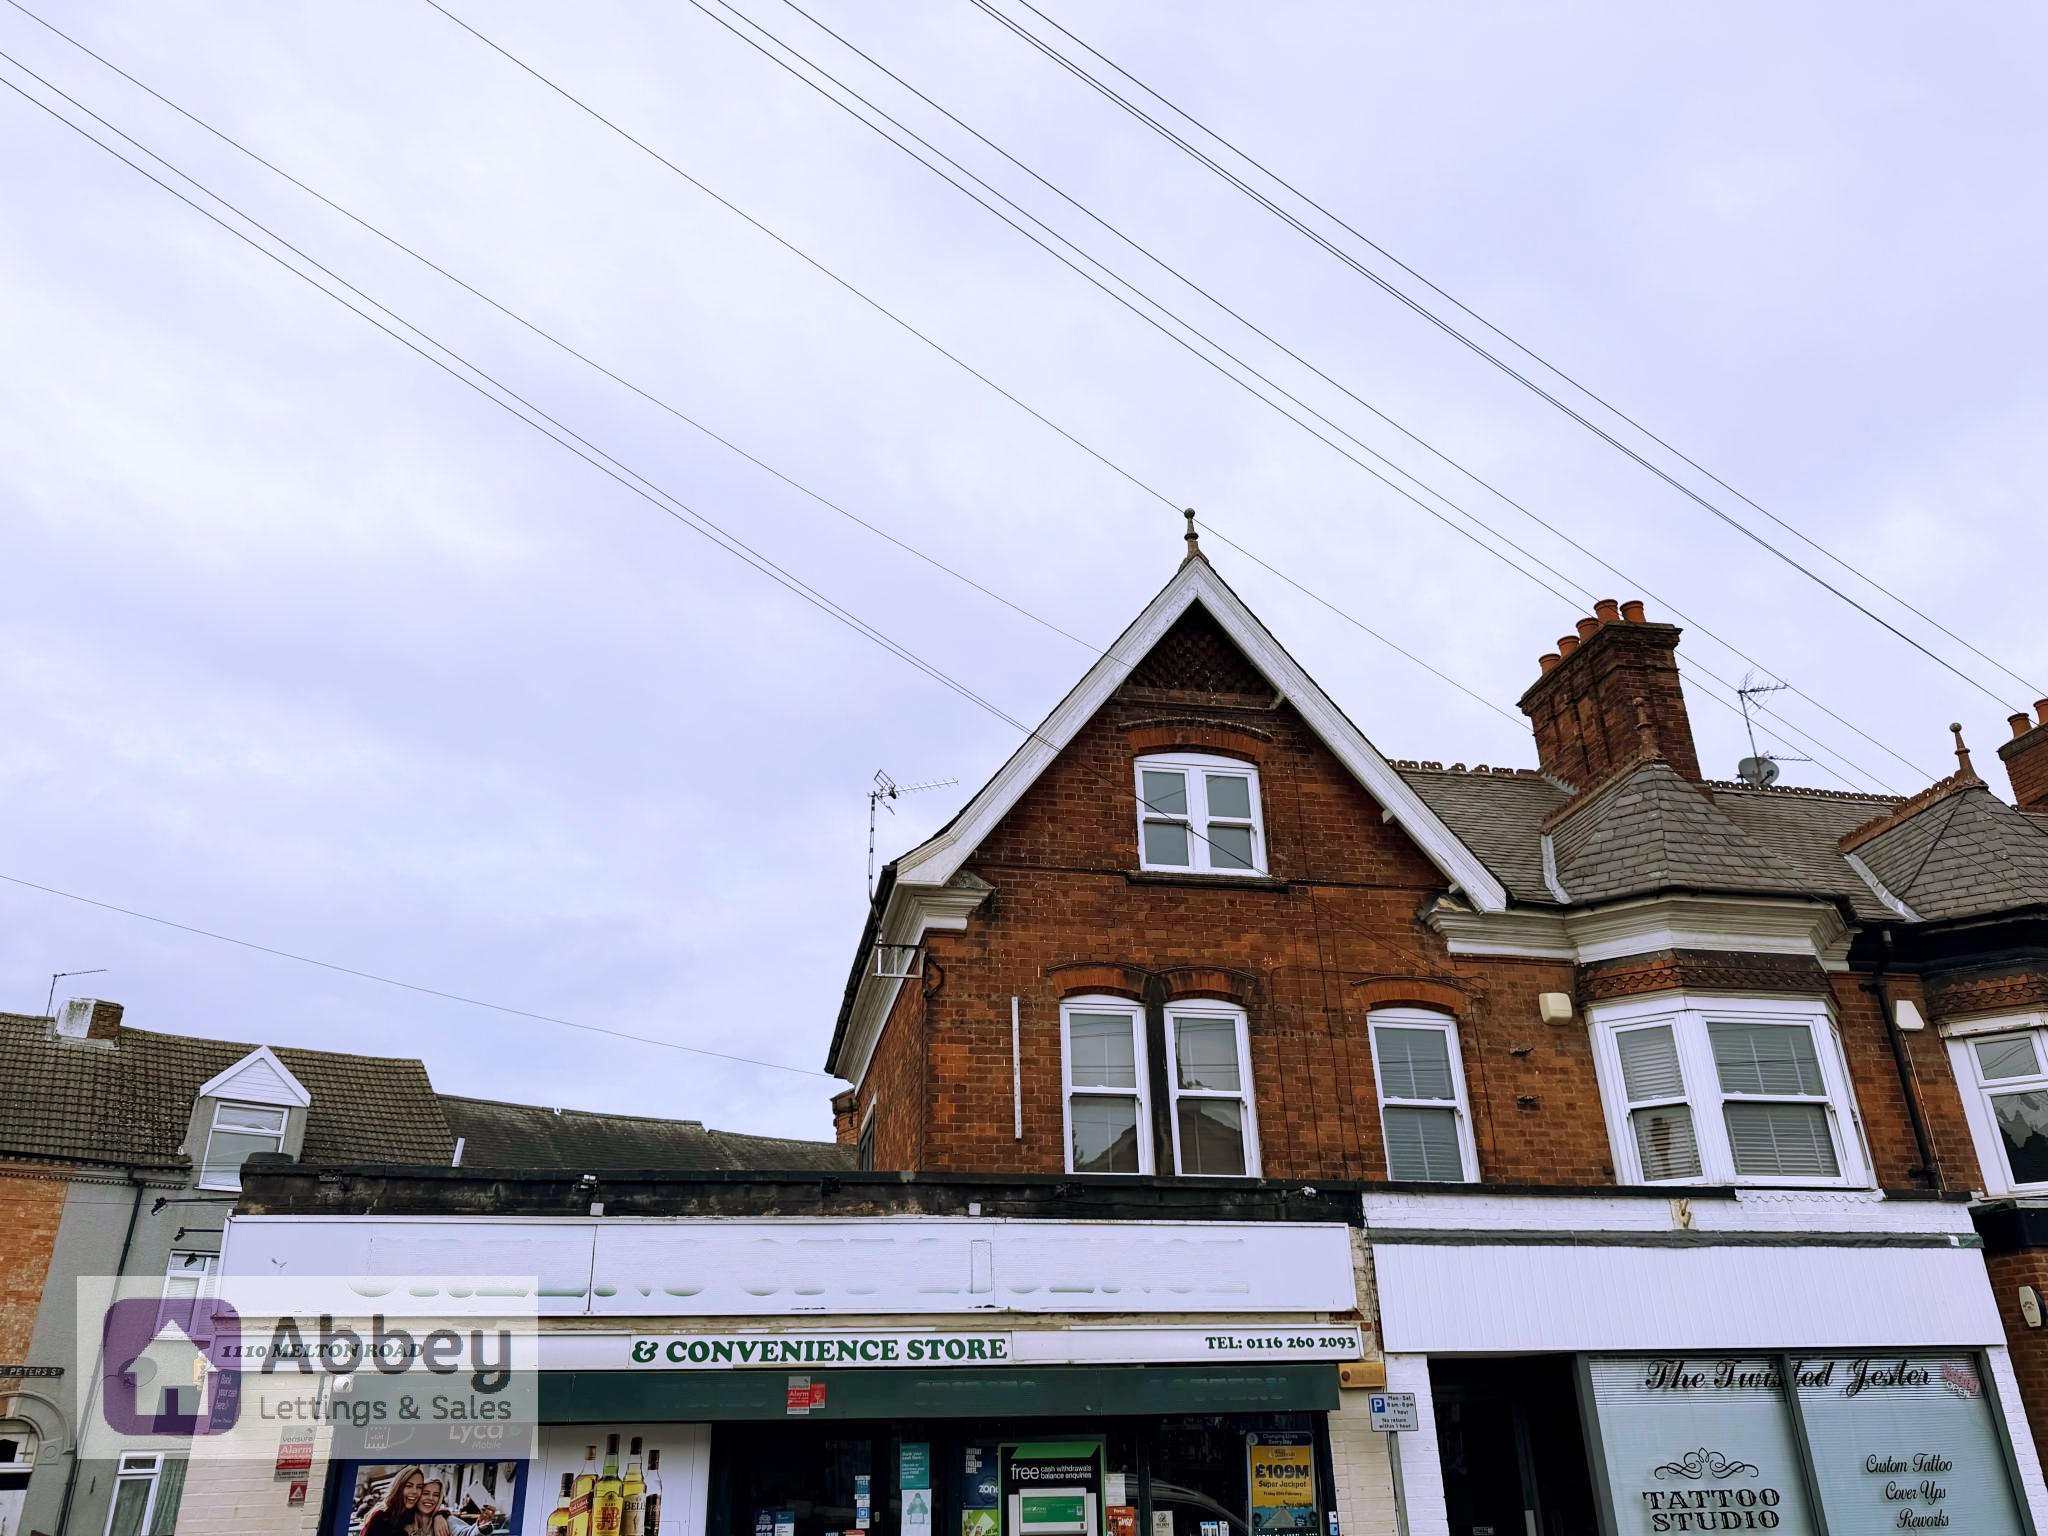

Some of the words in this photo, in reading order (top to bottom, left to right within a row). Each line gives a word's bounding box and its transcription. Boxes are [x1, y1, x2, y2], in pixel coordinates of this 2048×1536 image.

[220, 1345, 266, 1358] 1110
[271, 1343, 360, 1358] MELTON
[362, 1343, 425, 1358] ROAD
[631, 1340, 659, 1363] &
[666, 1339, 900, 1363] CONVENIENCE
[906, 1338, 1008, 1361] STORE
[1205, 1336, 1243, 1349] TEL:
[1246, 1336, 1283, 1349] 0116
[1286, 1336, 1315, 1348] 260
[1318, 1336, 1356, 1349] 2093
[9, 1367, 48, 1376] PETERS
[1645, 1359, 1705, 1389] The
[1845, 1358, 1932, 1398] Jester
[1374, 1399, 1383, 1412] P
[449, 1424, 504, 1444] Lyca
[280, 1445, 312, 1454] Alarm
[1010, 1463, 1040, 1481] free
[1040, 1464, 1056, 1472] cash
[1056, 1464, 1092, 1473] withdrawals
[1255, 1463, 1310, 1479] £109M
[1866, 1453, 1908, 1474] Custom
[1912, 1452, 1953, 1473] Tattoo
[1040, 1471, 1064, 1480] balance
[1065, 1472, 1092, 1480] enquiries
[1258, 1480, 1278, 1488] Super
[1280, 1480, 1307, 1489] Jackpot
[1642, 1488, 1781, 1510] TATTOO
[1885, 1480, 1918, 1501] Cover
[1920, 1479, 1946, 1506] Ups
[1651, 1509, 1780, 1533] STUDIO
[1896, 1507, 1950, 1529] Reworks
